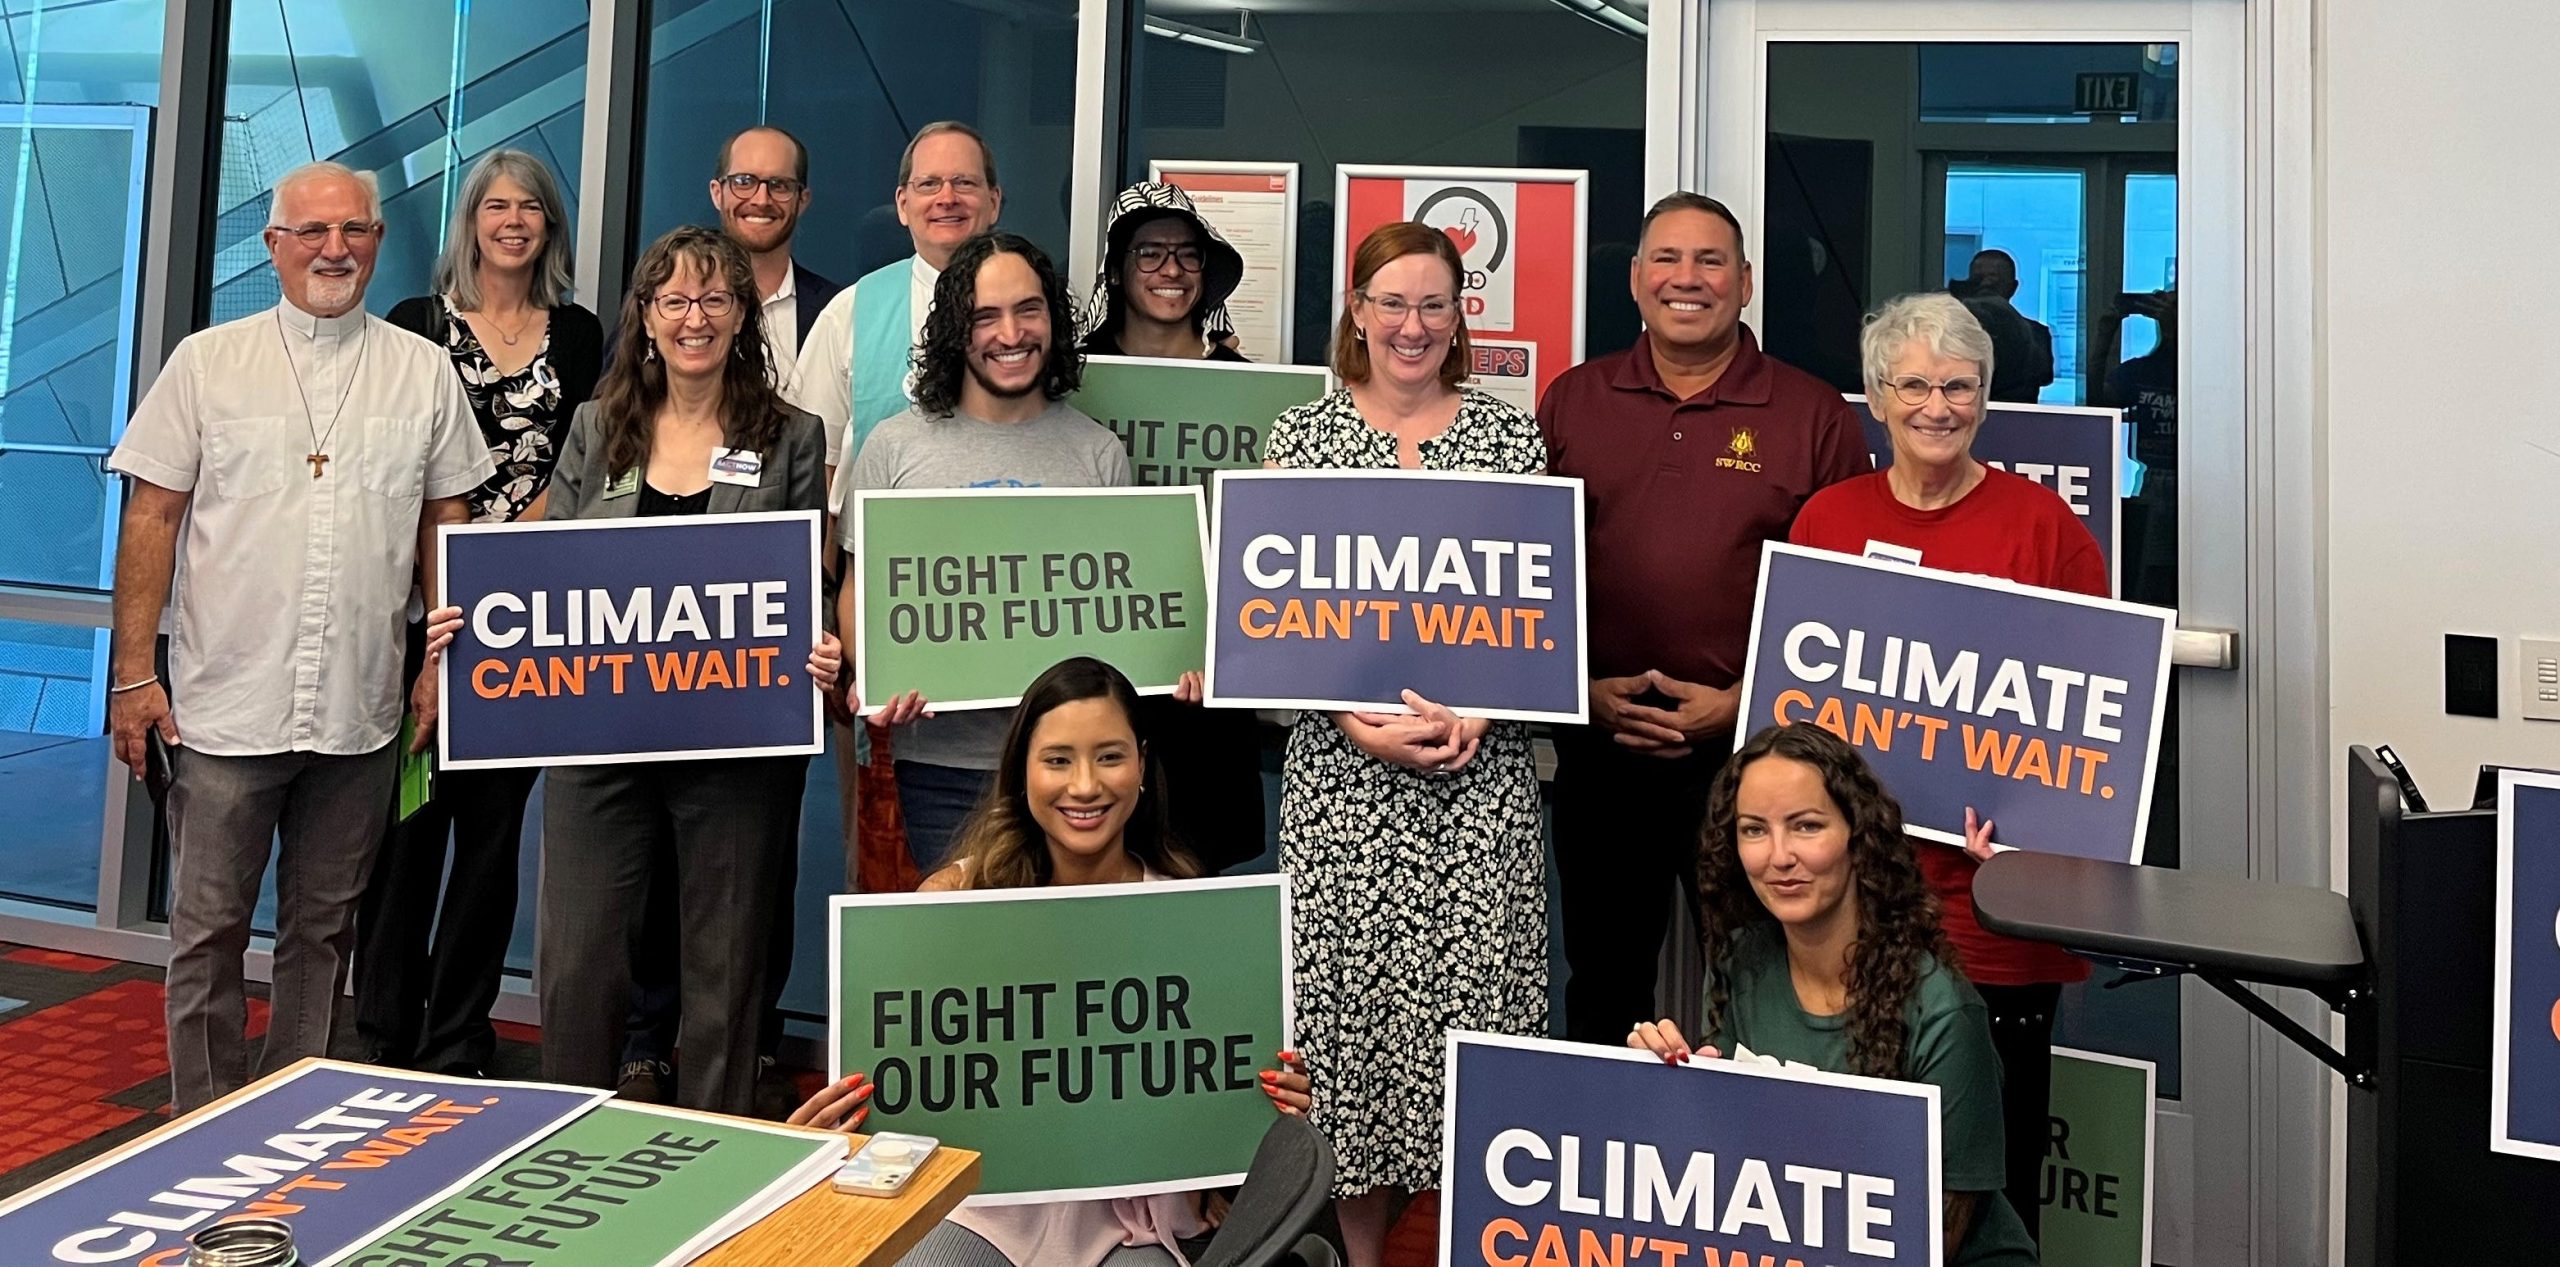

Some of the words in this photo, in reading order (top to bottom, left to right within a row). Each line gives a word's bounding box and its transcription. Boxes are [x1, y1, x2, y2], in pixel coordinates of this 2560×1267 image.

[1177, 422, 1259, 463] FOR
[1715, 457, 1762, 473] SWRCC
[889, 554, 1028, 597] FIGHT
[1042, 551, 1133, 592] FOR
[1242, 534, 1553, 600] CLIMATE
[472, 580, 788, 649] CLIMATE
[889, 602, 988, 644] OUR
[1003, 591, 1186, 639] FUTURE
[1239, 598, 1400, 641] CAN'T
[1411, 602, 1555, 650] WAIT.
[471, 653, 633, 699] CAN'T
[645, 647, 790, 693] WAIT.
[1783, 621, 2129, 743] CLIMATE
[1961, 724, 2115, 799] WAIT.
[873, 983, 1057, 1048] FIGHT
[1075, 975, 1192, 1037] FOR
[872, 1052, 1001, 1115] OUR
[1021, 1034, 1255, 1106] FUTURE
[320, 1096, 500, 1169] WAIT.
[52, 1087, 438, 1264] CLIMATE
[464, 1148, 610, 1210] FOR
[491, 1130, 721, 1250] FUTURE
[1484, 1128, 1896, 1259] CLIMATE
